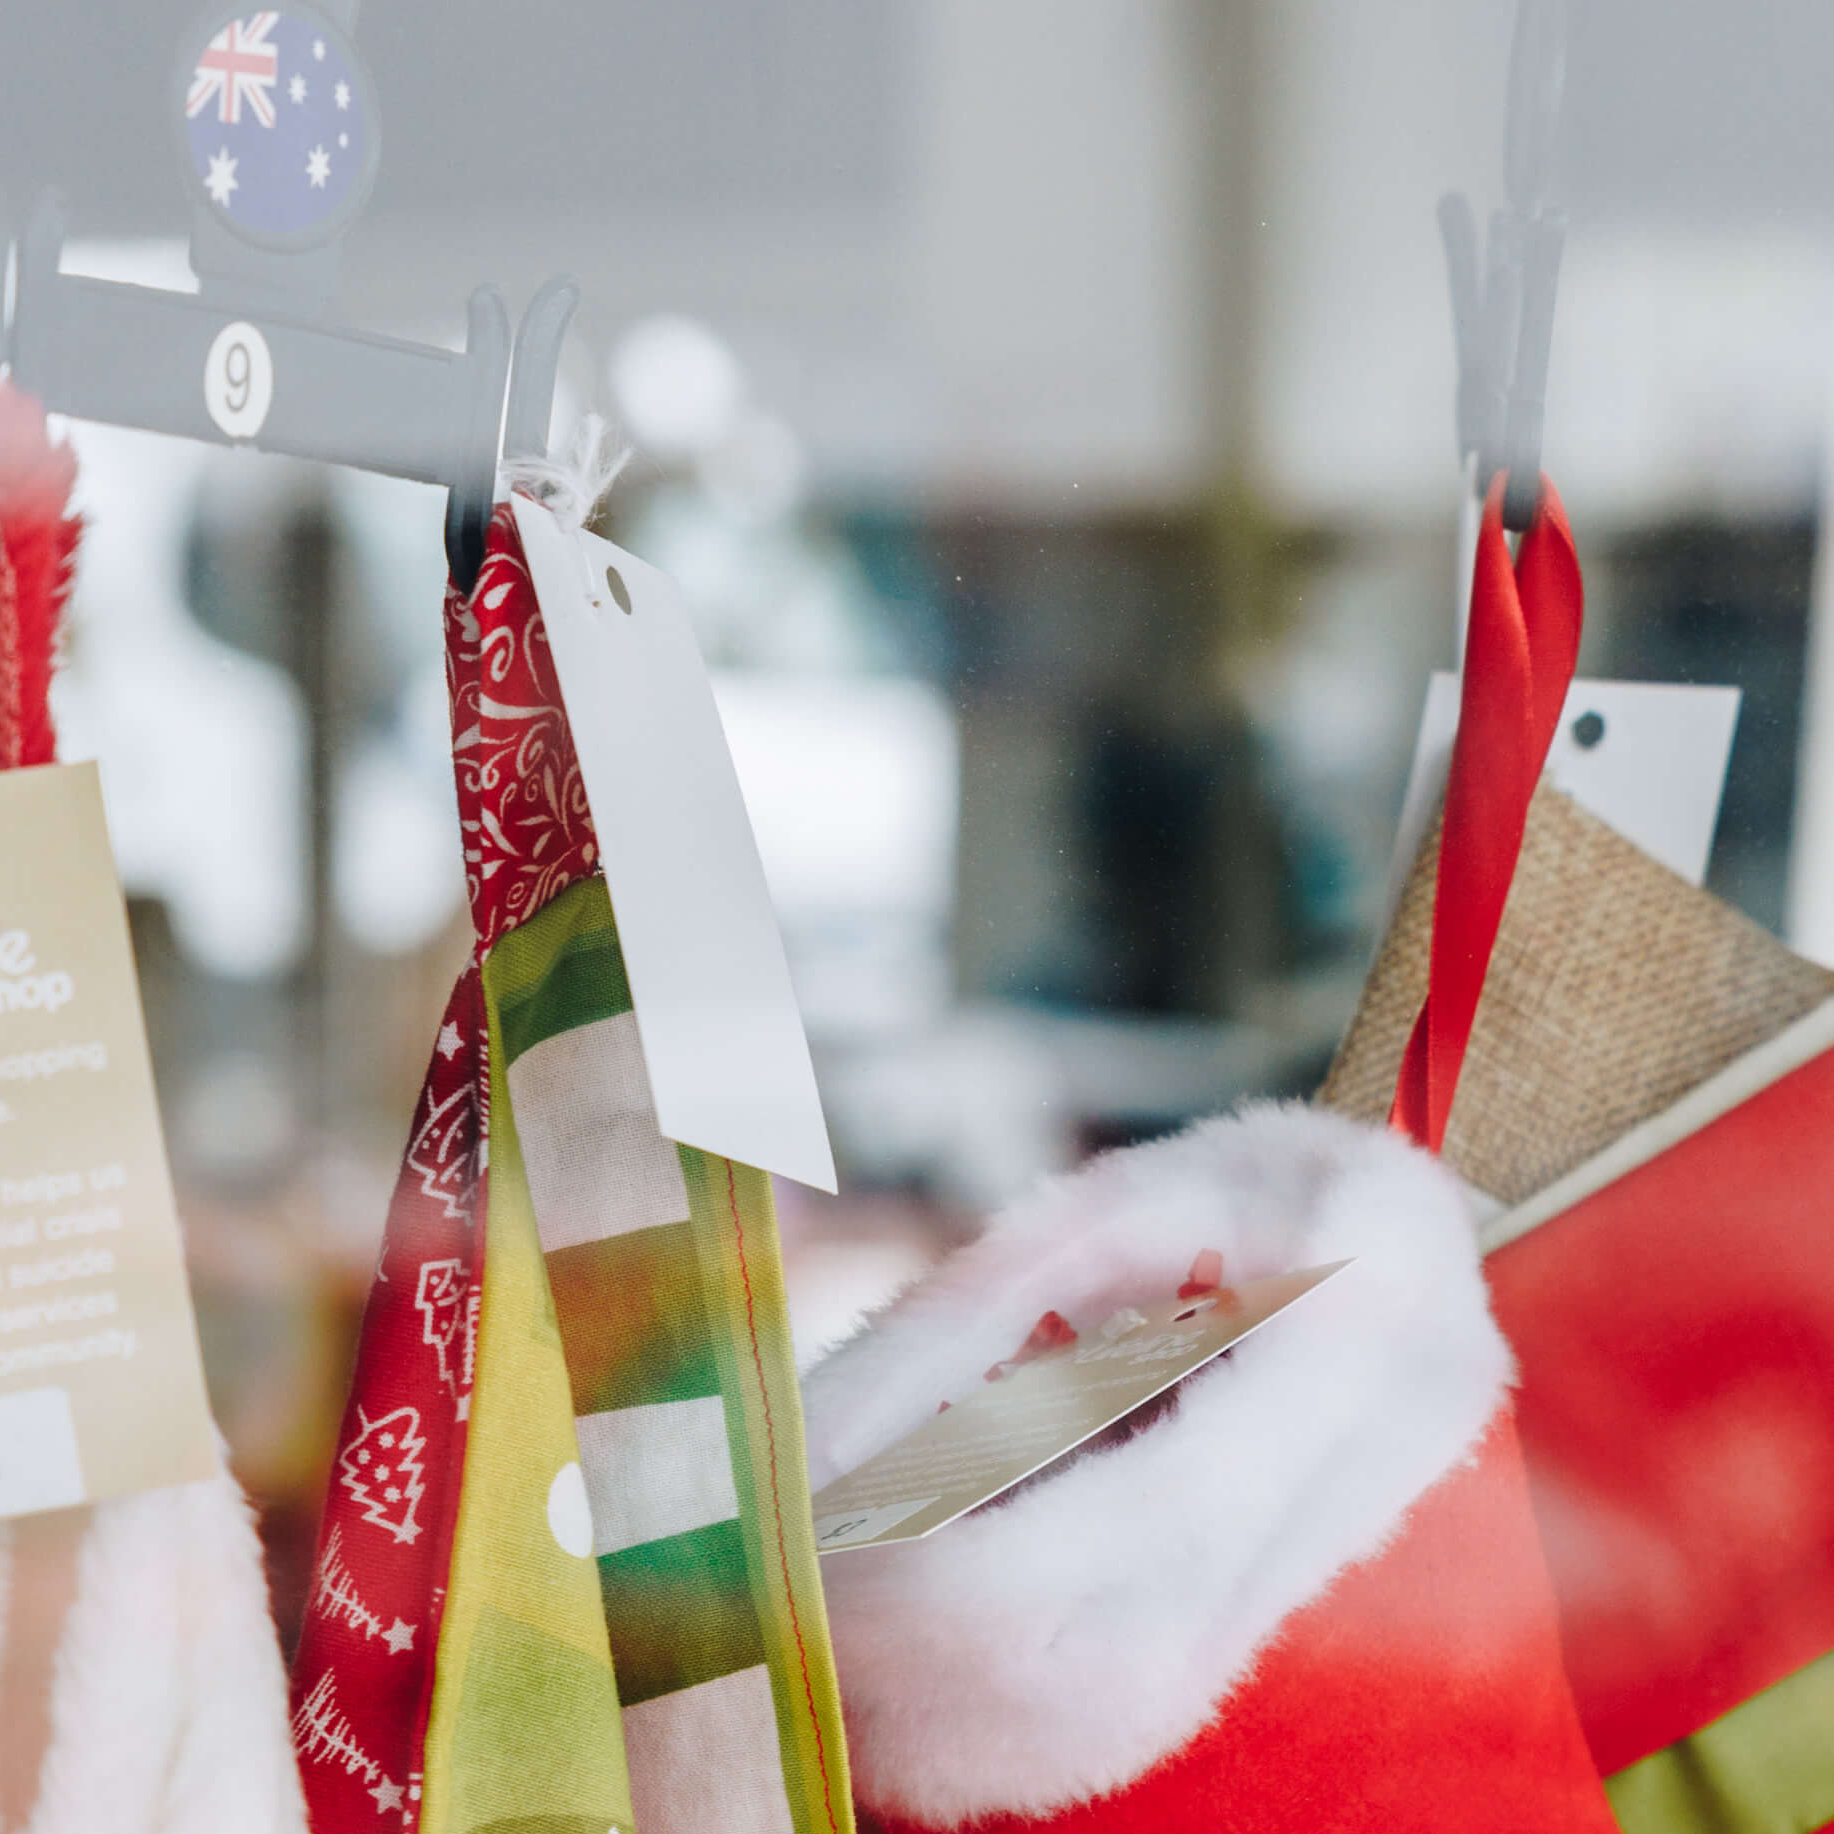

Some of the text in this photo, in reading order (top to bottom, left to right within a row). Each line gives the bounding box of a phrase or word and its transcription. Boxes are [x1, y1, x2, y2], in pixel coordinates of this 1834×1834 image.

[225, 341, 251, 414] 9
[0, 1171, 85, 1207] helps
[89, 1162, 129, 1191] us
[8, 1247, 116, 1291] suicide
